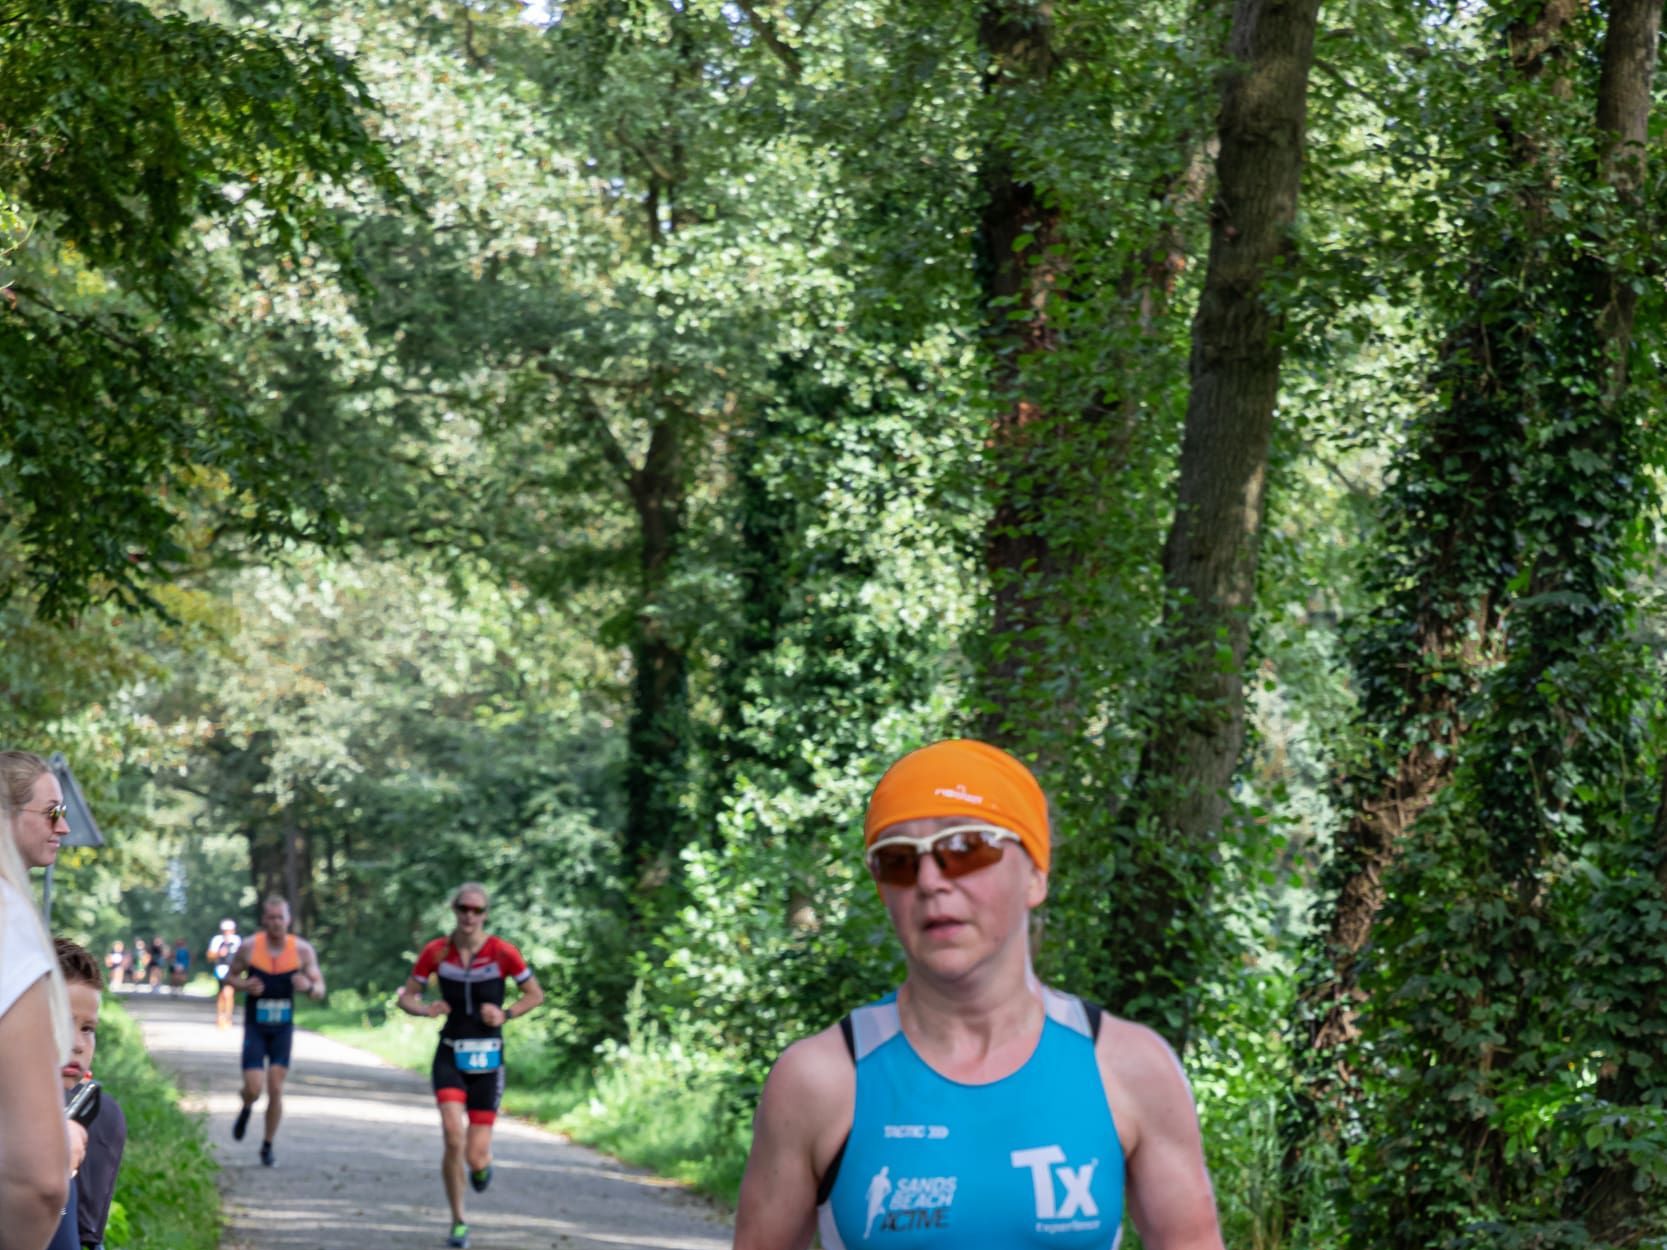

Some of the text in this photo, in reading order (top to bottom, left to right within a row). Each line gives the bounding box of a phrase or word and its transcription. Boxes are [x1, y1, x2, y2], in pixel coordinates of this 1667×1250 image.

[896, 1176, 958, 1193] SANDS
[889, 1190, 955, 1210] BEACH
[880, 1208, 950, 1232] ACTIVE
